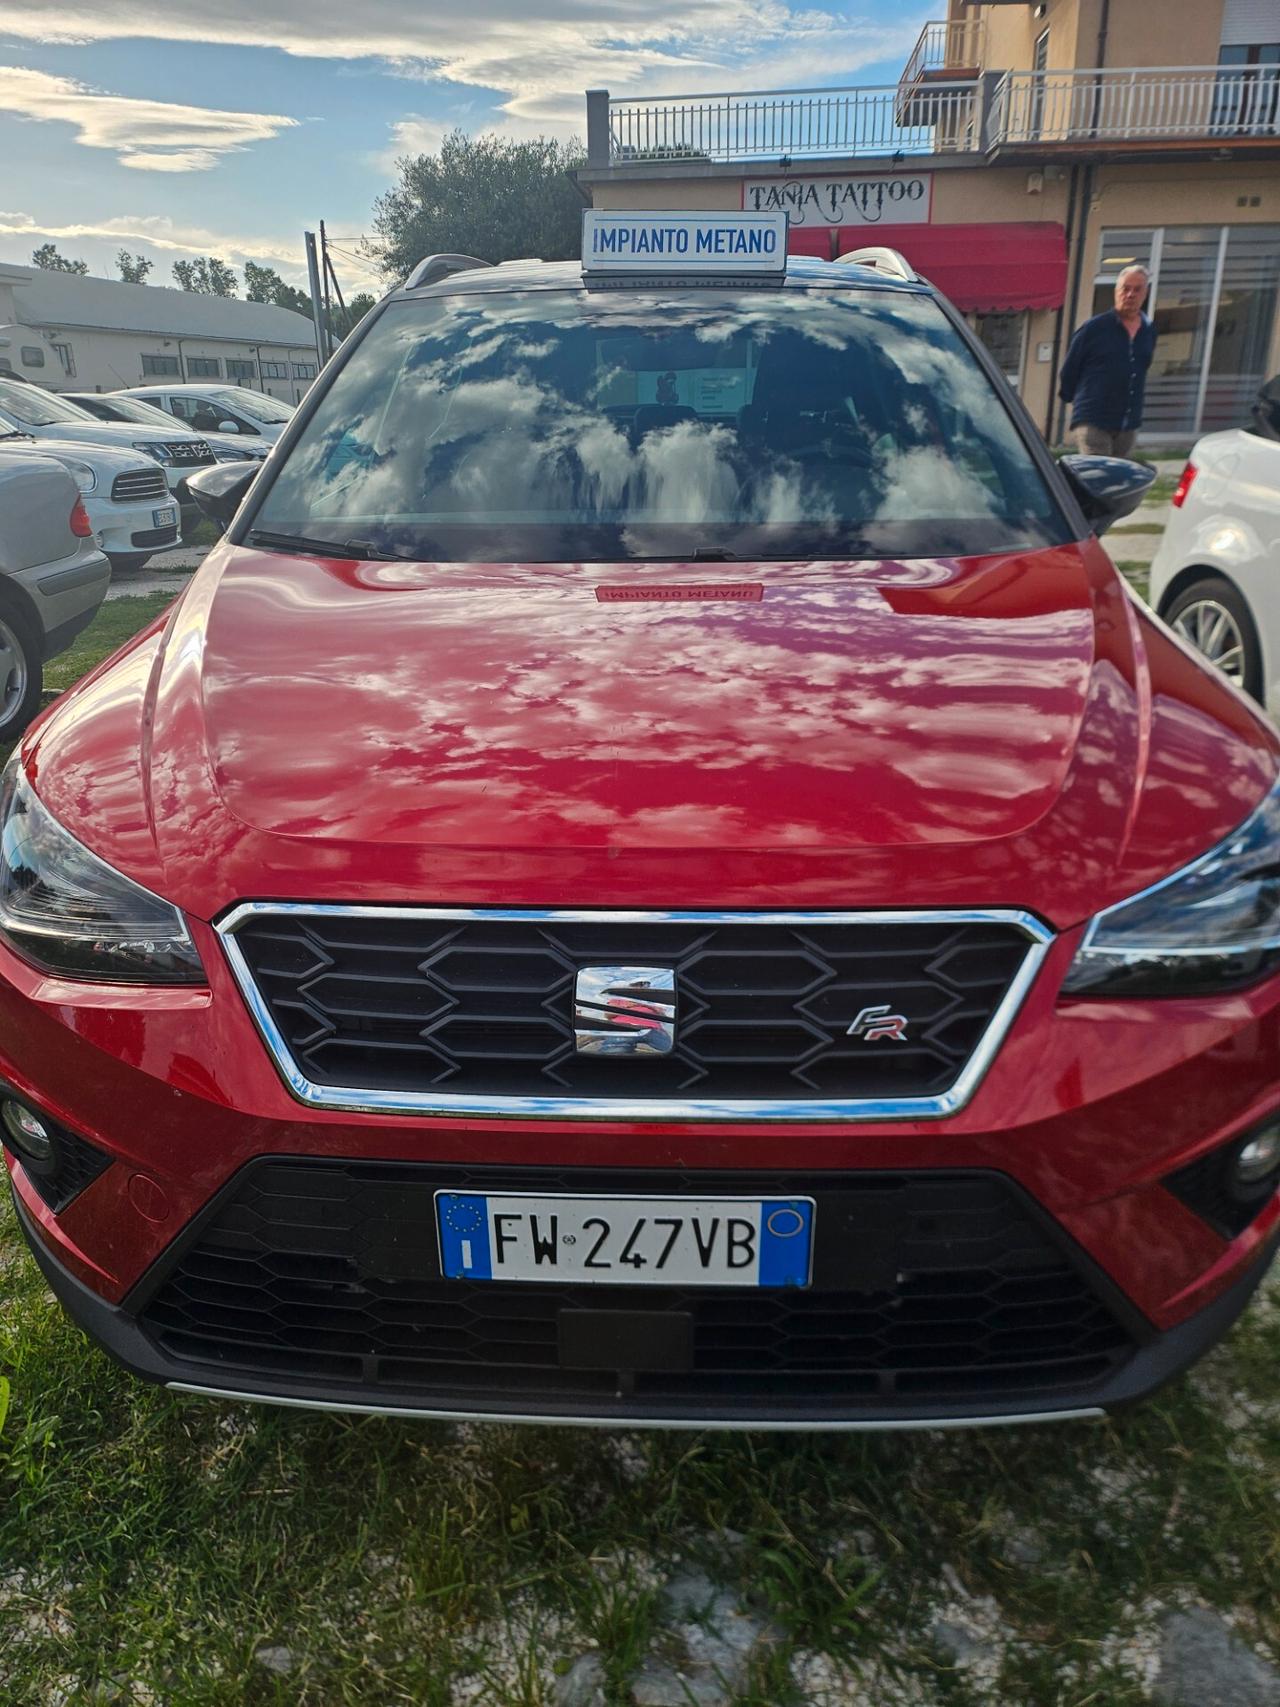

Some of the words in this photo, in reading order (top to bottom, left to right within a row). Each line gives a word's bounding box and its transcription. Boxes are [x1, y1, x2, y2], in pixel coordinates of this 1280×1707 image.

[750, 181, 826, 223] TANIA
[826, 180, 925, 223] TATTOO
[593, 228, 689, 254] IMPIANTO
[695, 228, 777, 254] METANO
[846, 1005, 909, 1041] FR
[493, 1213, 558, 1266] FW
[582, 1217, 756, 1269] 247VB
